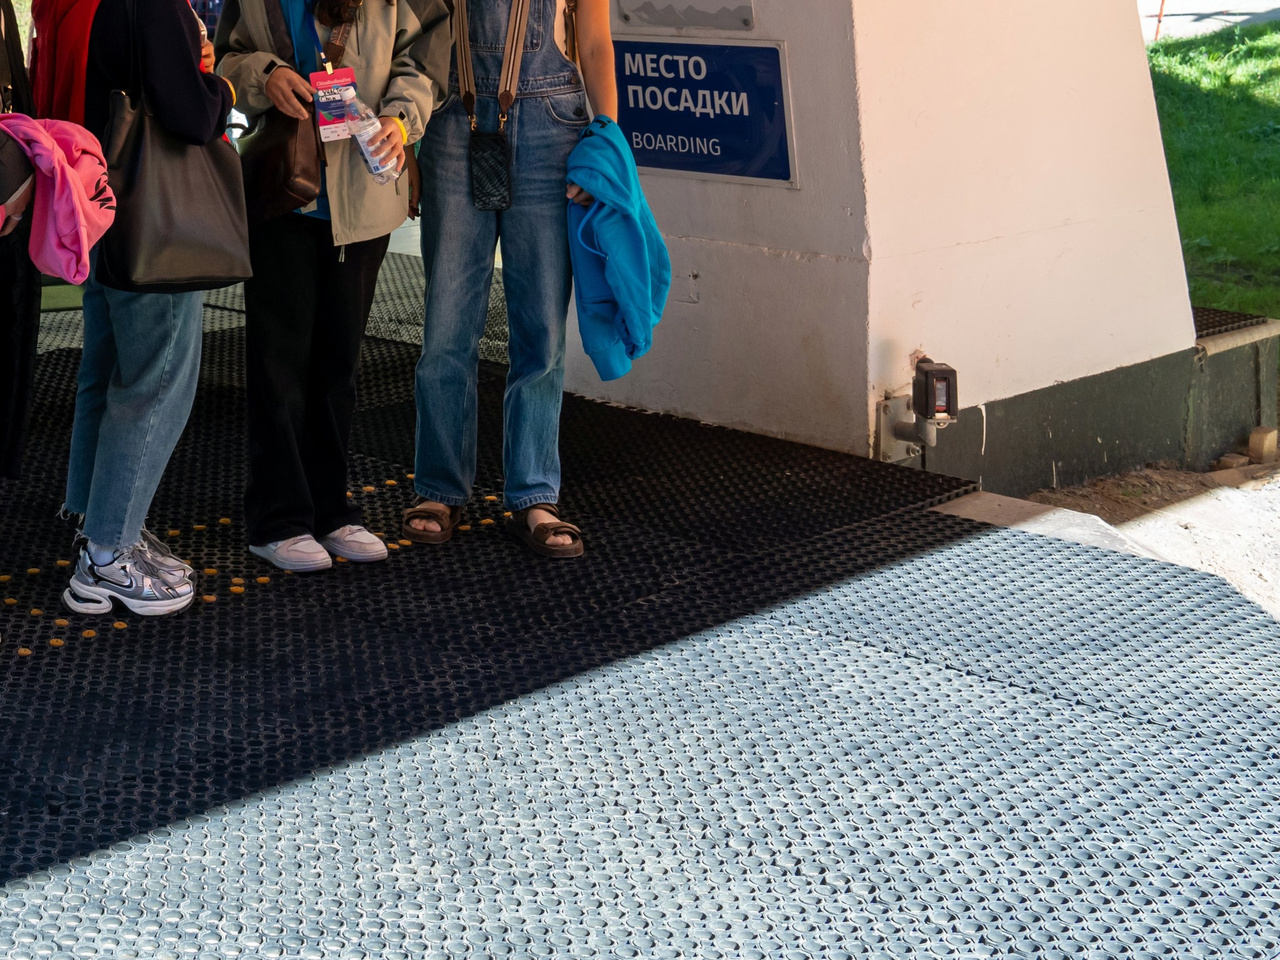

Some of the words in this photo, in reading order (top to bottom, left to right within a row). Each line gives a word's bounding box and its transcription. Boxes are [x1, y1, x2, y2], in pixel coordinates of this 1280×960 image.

[624, 52, 707, 81] МЕСТО
[627, 85, 750, 119] ПОСАДКИ
[632, 132, 721, 156] BOARDING
